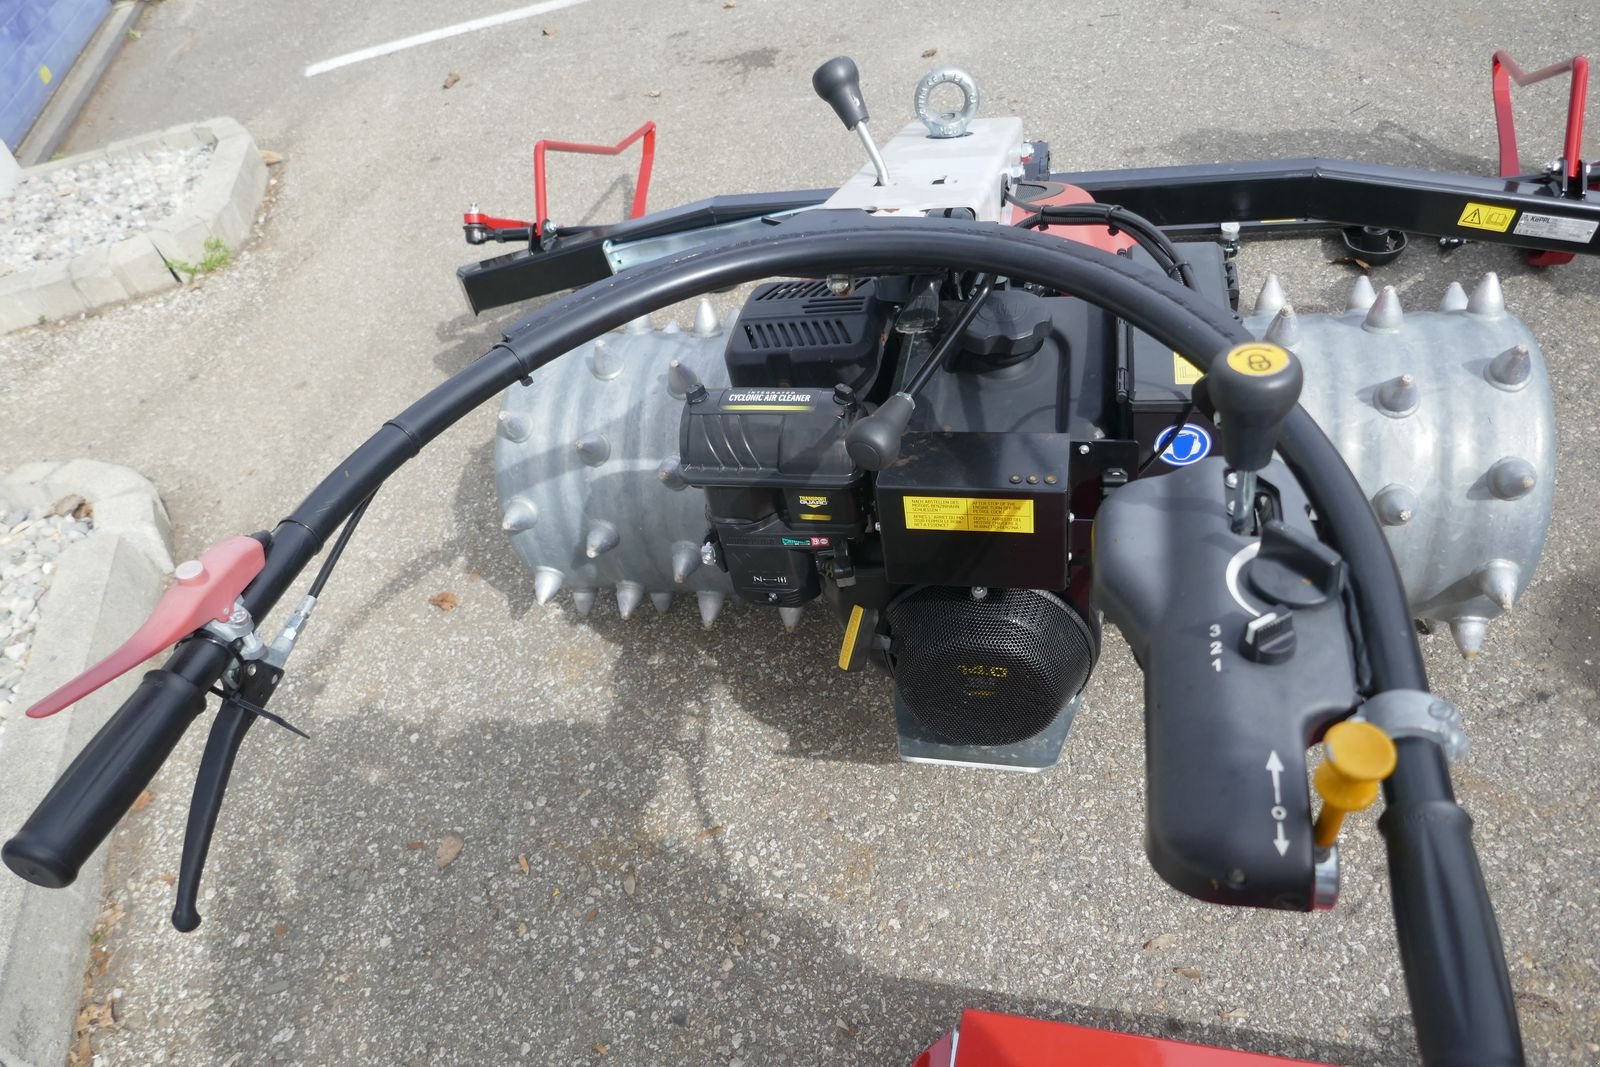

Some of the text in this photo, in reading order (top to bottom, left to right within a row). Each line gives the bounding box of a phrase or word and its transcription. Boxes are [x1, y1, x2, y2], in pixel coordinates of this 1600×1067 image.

[1209, 624, 1222, 637] 3
[1210, 641, 1223, 655] 2
[1211, 658, 1222, 672] 1
